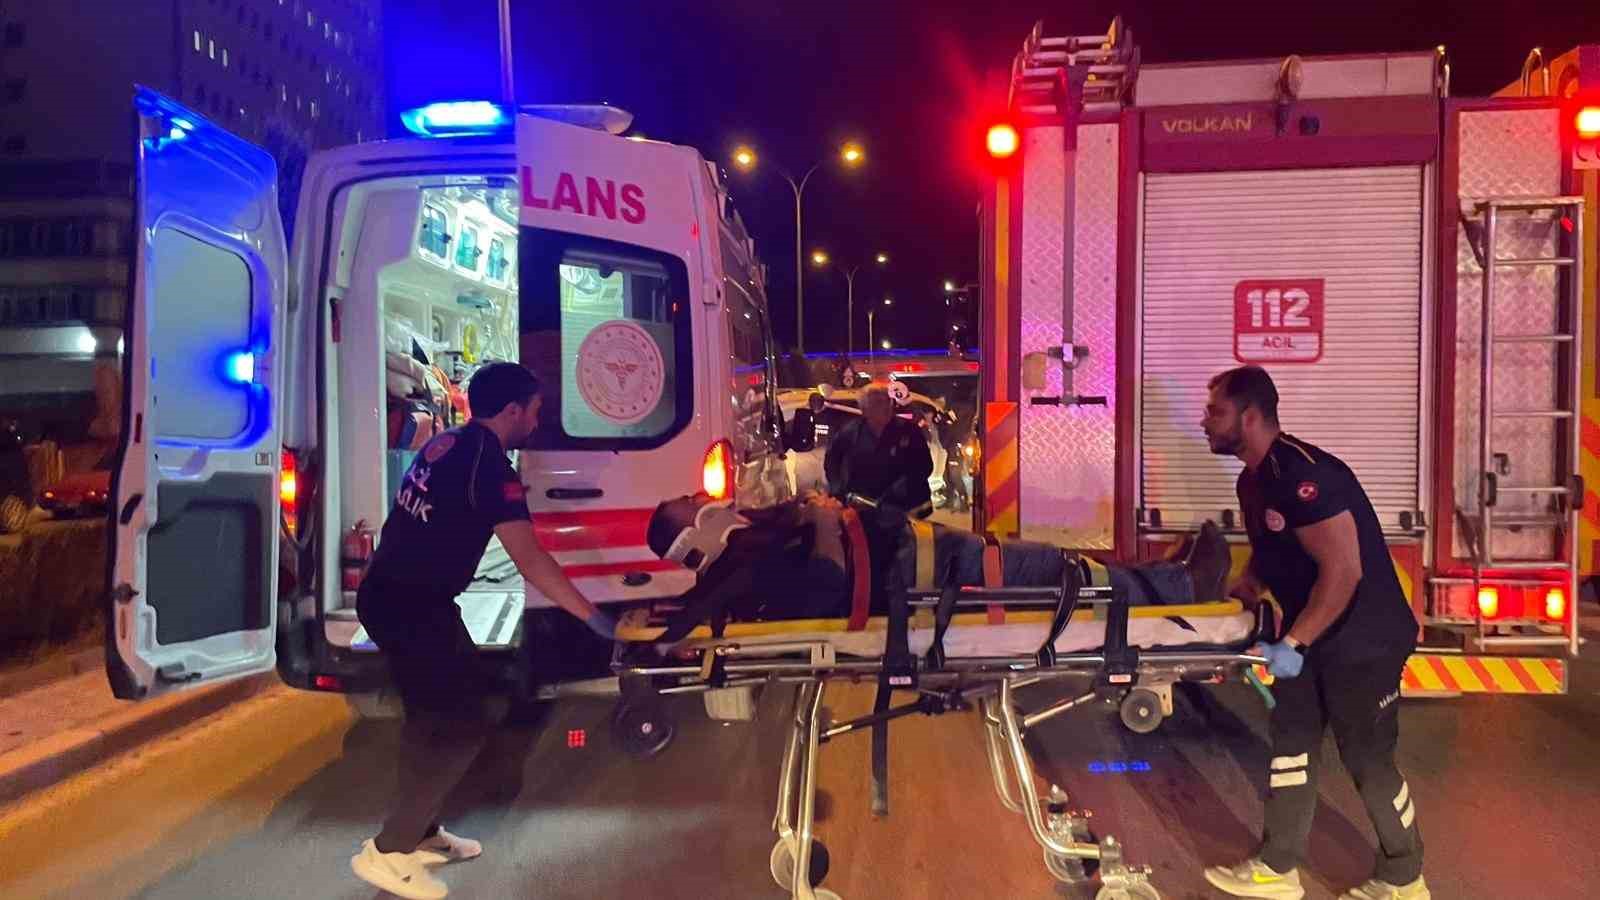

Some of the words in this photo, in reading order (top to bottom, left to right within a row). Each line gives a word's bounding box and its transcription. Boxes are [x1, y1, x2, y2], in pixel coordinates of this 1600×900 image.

[1162, 112, 1252, 133] VOLKAN
[521, 165, 646, 225] LANS
[1247, 287, 1312, 328] 112
